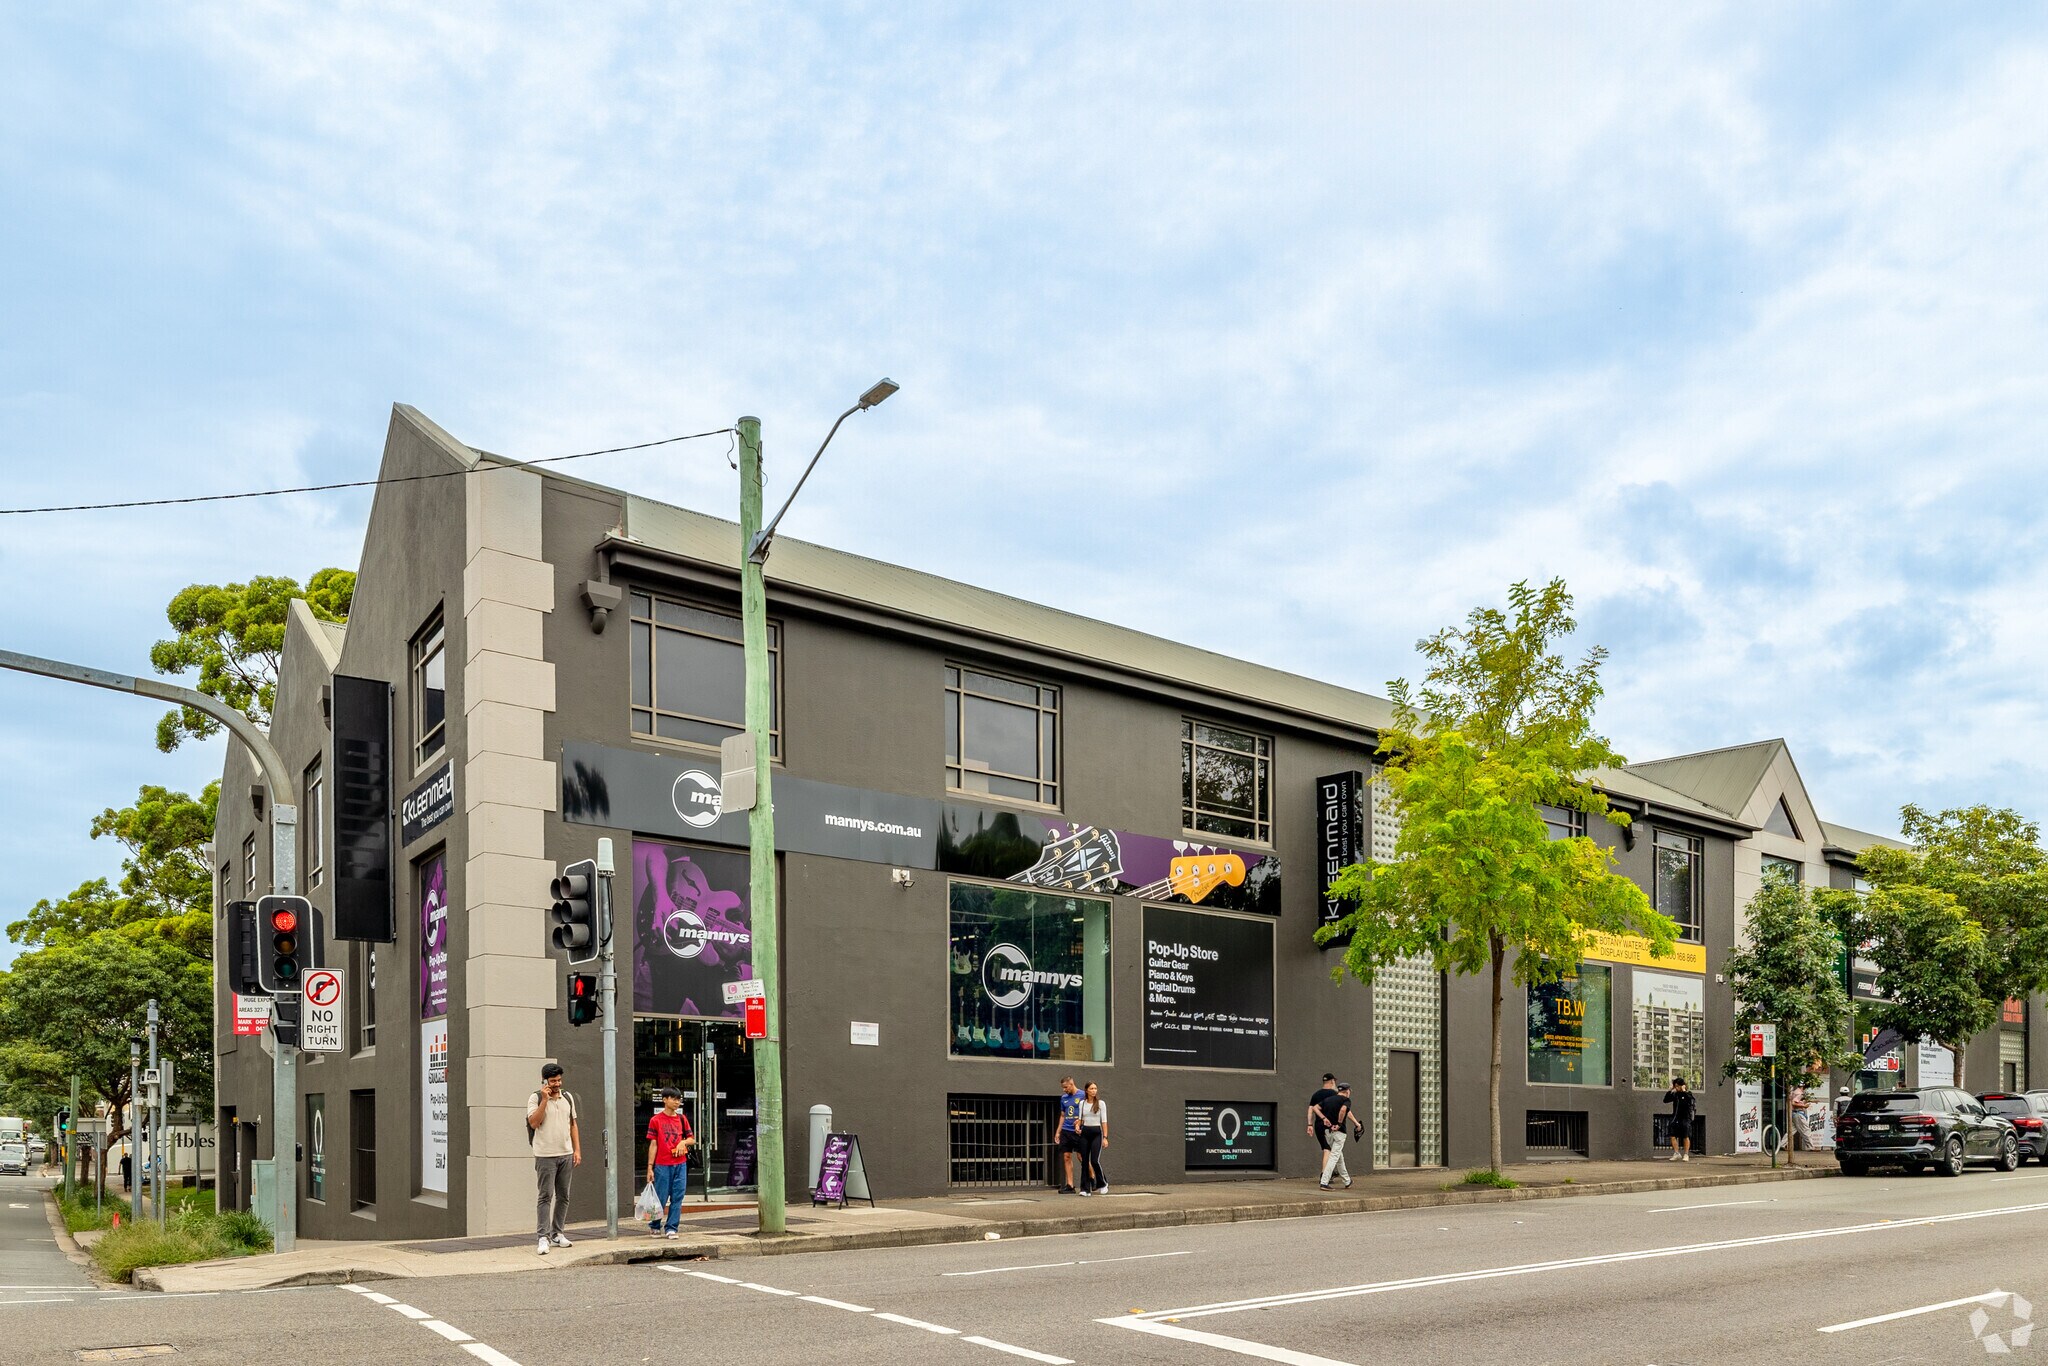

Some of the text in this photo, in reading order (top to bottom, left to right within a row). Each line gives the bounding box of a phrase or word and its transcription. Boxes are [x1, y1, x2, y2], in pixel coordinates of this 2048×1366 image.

[825, 814, 922, 837] mannys.com.au
[1098, 834, 1116, 862] Gibson
[679, 927, 750, 944] mannys
[1148, 940, 1219, 961] Pop-Up Store
[1600, 936, 1651, 952] BOTANY WATERLO
[1600, 947, 1640, 960] DISPLAY SUITE
[1149, 958, 1189, 970] Guitar Gear
[1000, 968, 1083, 989] mannys
[1149, 969, 1194, 983] Piano & Keys
[1149, 981, 1196, 994] Digital Drums
[1149, 993, 1176, 1004] & More.
[1555, 998, 1587, 1017] TB.W
[312, 1010, 333, 1022] NO
[306, 1025, 338, 1034] RIGHT
[308, 1036, 337, 1045] TURN
[1887, 1057, 1899, 1071] DJ
